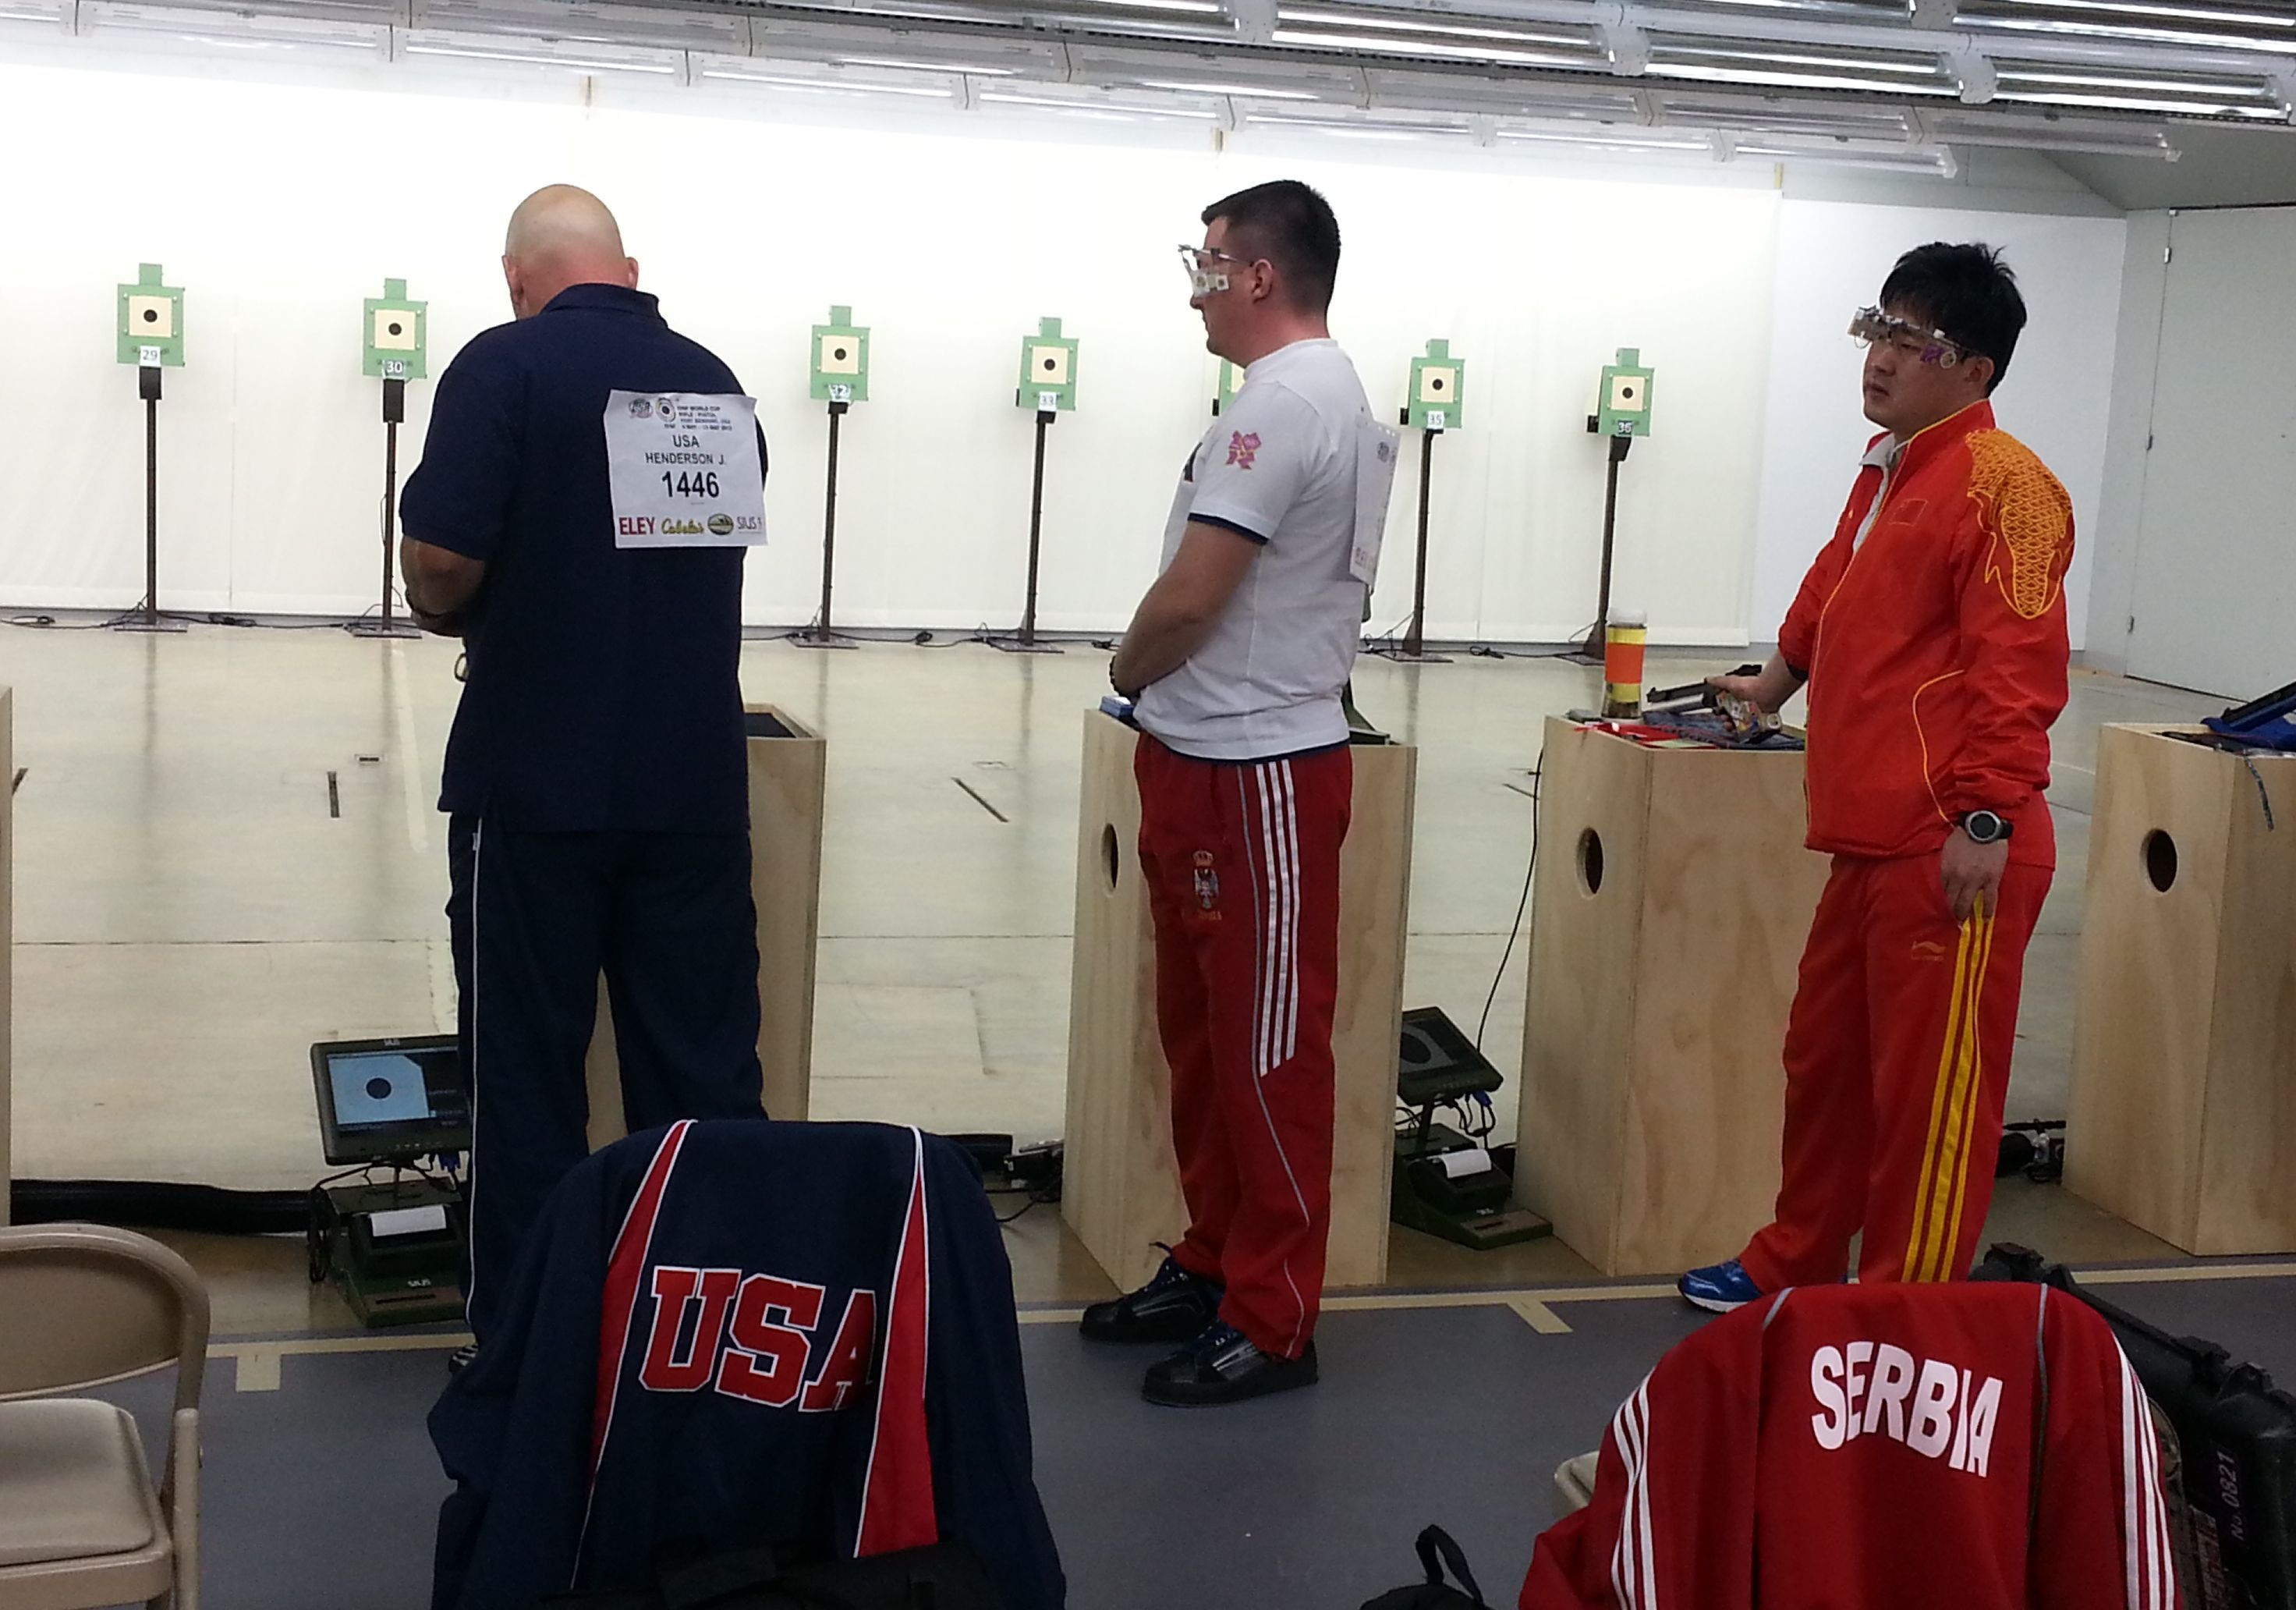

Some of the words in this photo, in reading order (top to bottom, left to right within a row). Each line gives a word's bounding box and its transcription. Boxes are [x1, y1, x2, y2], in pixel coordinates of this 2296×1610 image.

[142, 349, 158, 361] 29
[386, 360, 403, 373] 30
[1618, 422, 1632, 433] 36
[672, 434, 700, 449] USA
[645, 452, 714, 465] HENDERSON
[718, 455, 727, 466] J.
[662, 470, 720, 498] 1446
[618, 516, 656, 535] ELEY
[638, 1265, 877, 1413] USA
[1811, 1341, 2004, 1478] SERBIA
[2216, 1449, 2241, 1508] 0821
